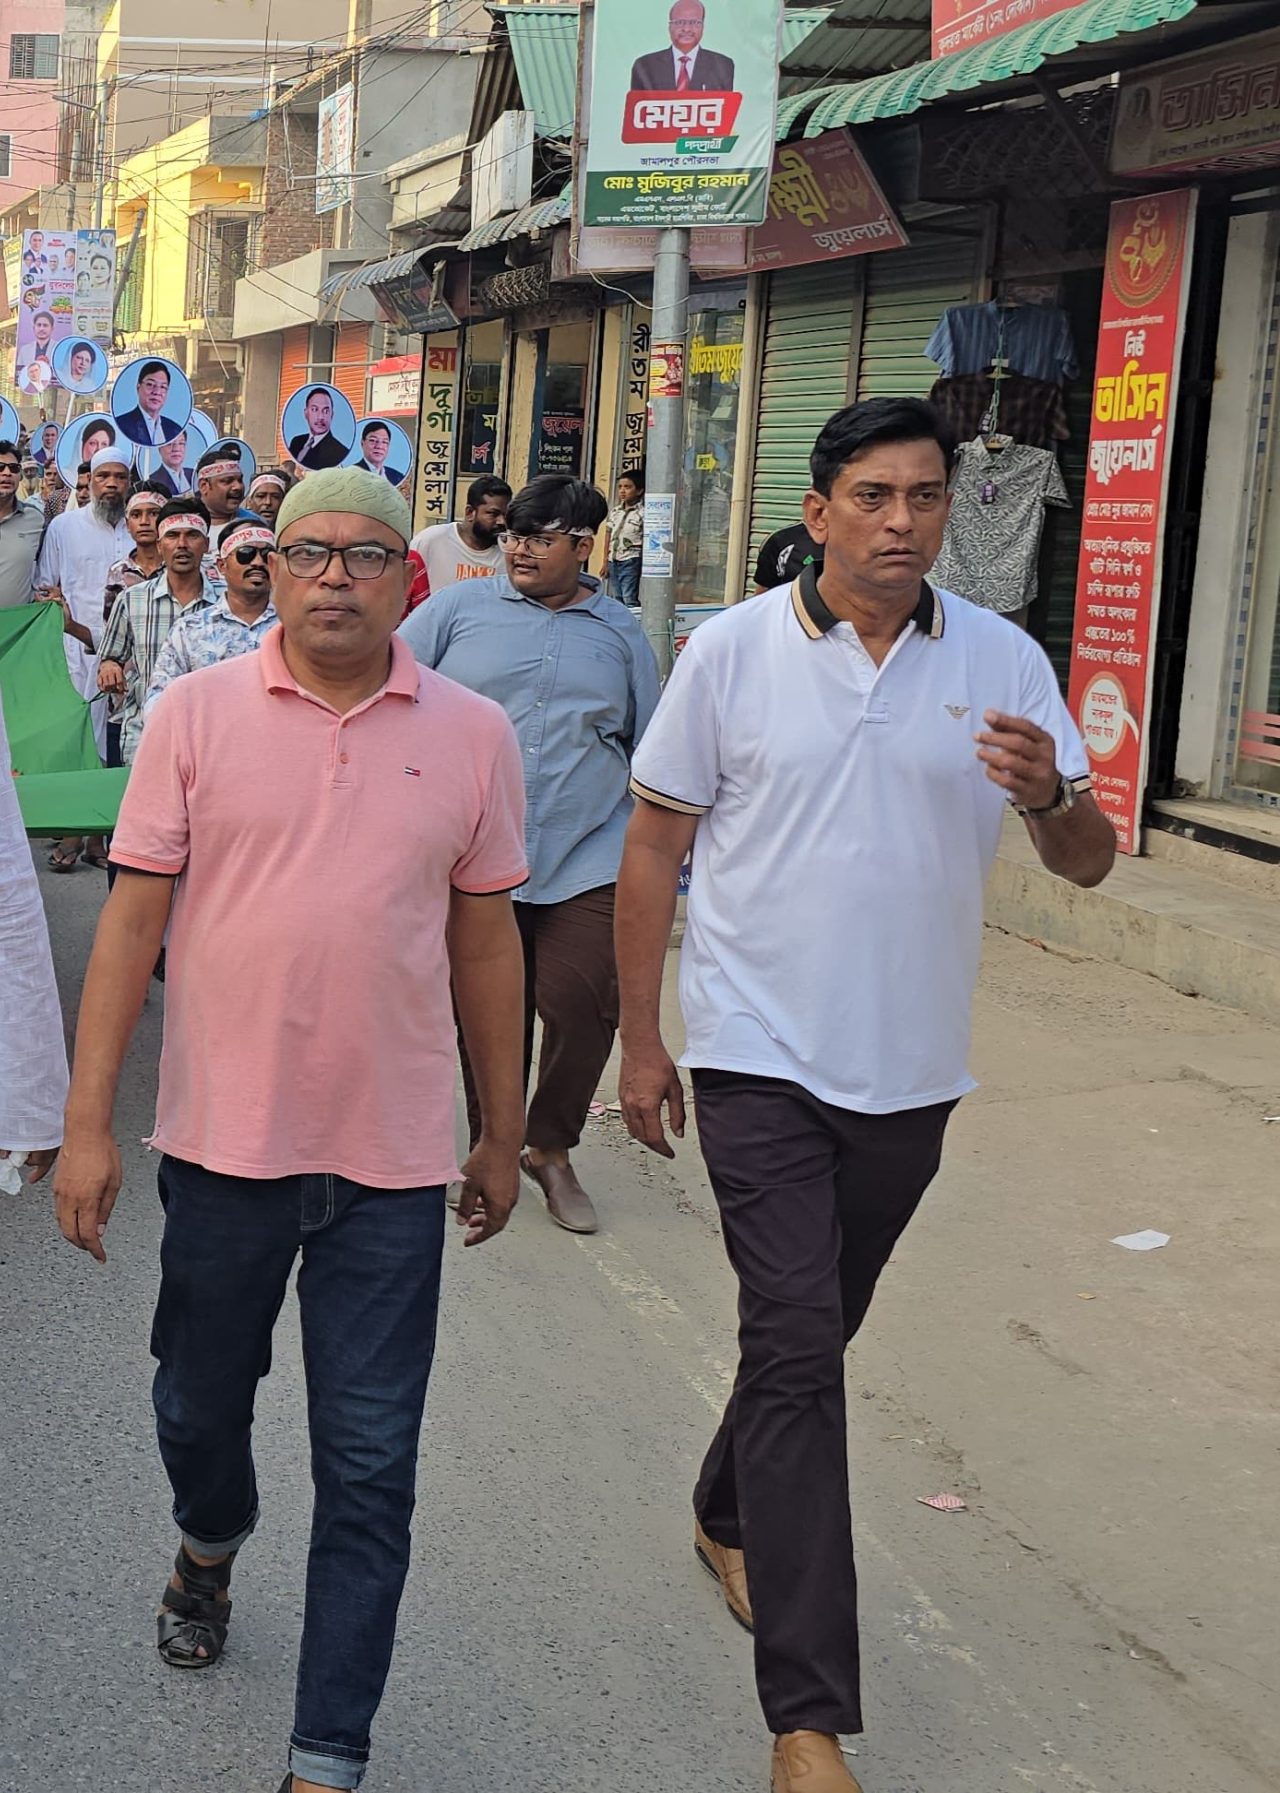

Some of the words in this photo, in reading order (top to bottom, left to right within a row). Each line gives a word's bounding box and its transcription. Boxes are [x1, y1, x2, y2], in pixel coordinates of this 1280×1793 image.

[632, 98, 725, 133] মেয়র
[640, 156, 680, 168] জামালপুর
[682, 155, 720, 166] পৌরসভা
[603, 175, 633, 190] মোঃ
[637, 172, 695, 194] মুজিবুর
[697, 173, 750, 190] রহমান
[811, 213, 893, 252] জুয়েলার্স
[428, 347, 458, 373] মা
[1094, 359, 1168, 423] তাসিন
[1089, 424, 1163, 485] জুয়েলার্স
[1135, 564, 1142, 576] ও
